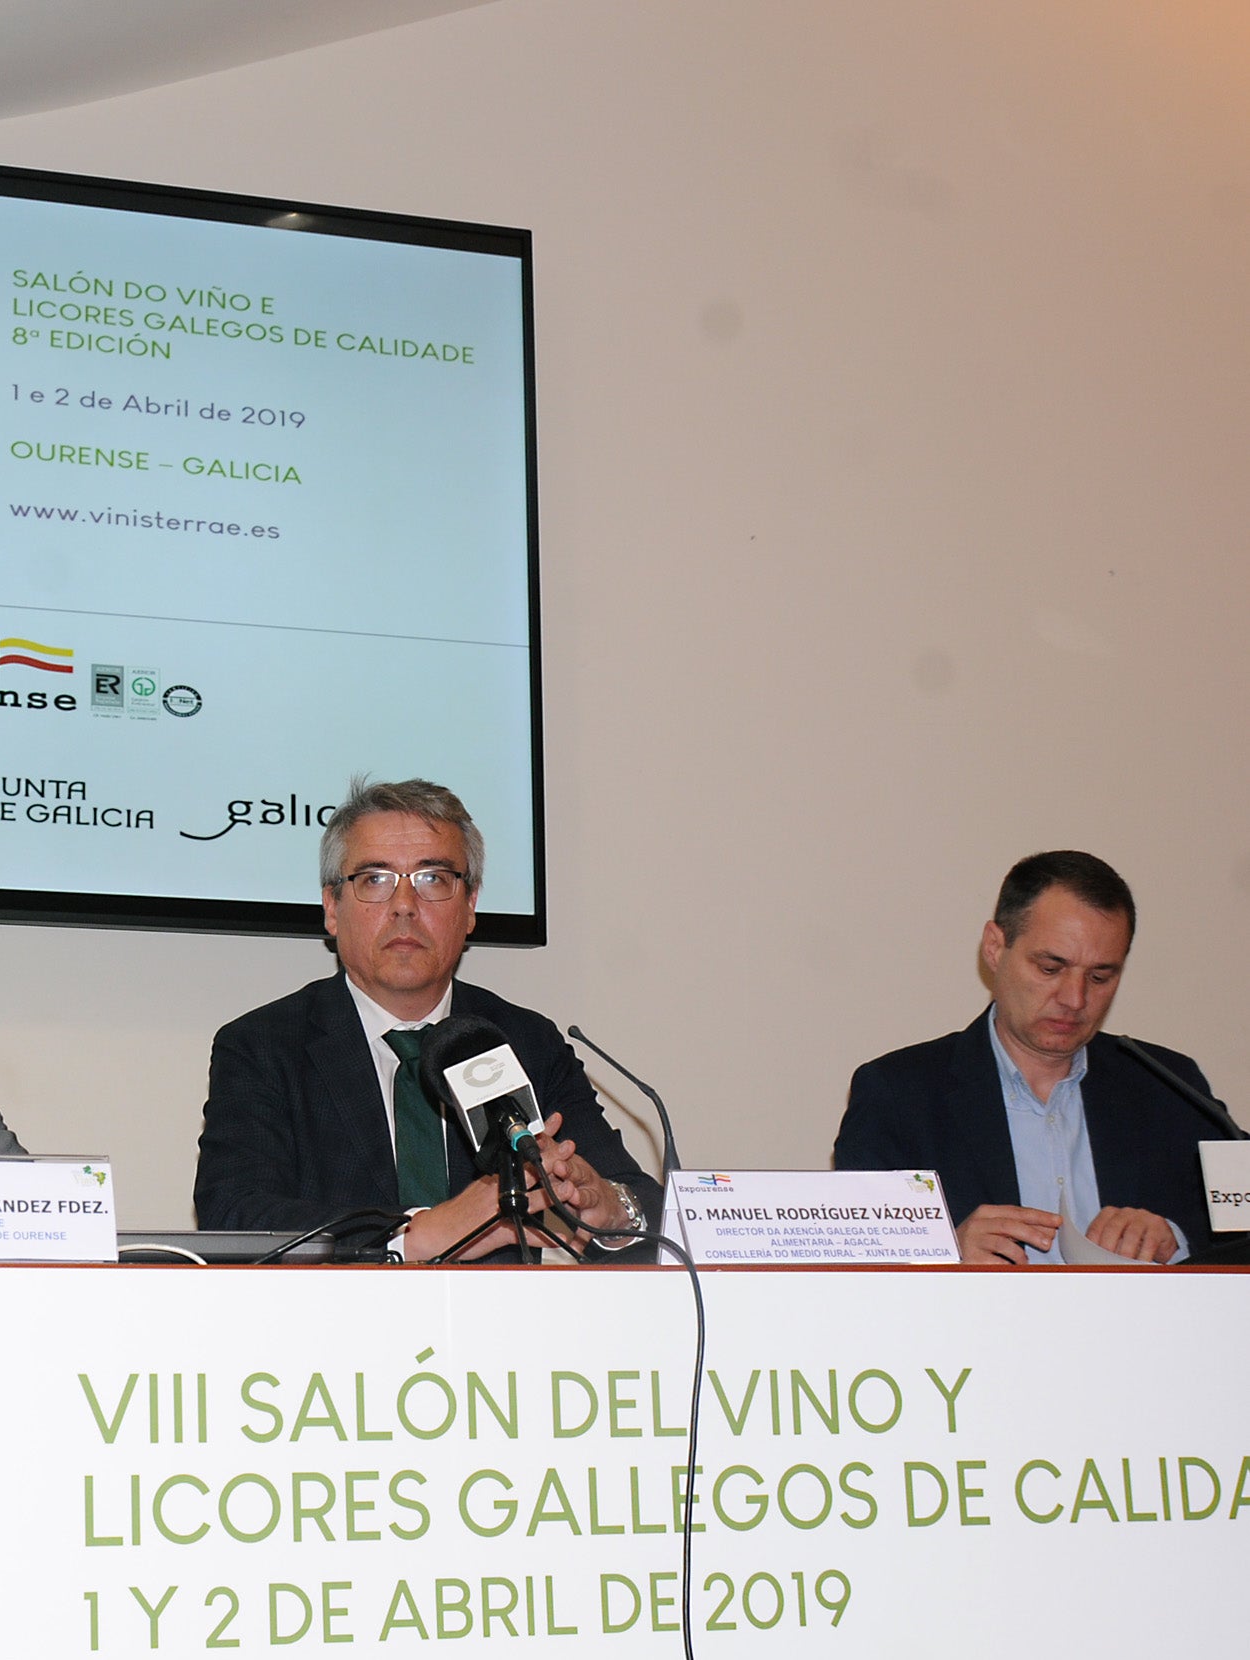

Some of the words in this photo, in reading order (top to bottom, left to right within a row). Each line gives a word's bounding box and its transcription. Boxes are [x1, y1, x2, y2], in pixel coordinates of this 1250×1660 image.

[12, 269, 113, 297] SALÓN
[125, 281, 166, 302] DO
[177, 285, 250, 312] VIÑO
[261, 297, 274, 315] E
[13, 298, 134, 327] LICORES
[144, 313, 284, 343] GALEGOS
[295, 329, 326, 348] DE
[337, 333, 475, 364] CALIDADE
[50, 330, 171, 360] EDICIÓN
[12, 384, 20, 401] 1
[30, 390, 44, 405] e
[55, 388, 69, 406] 2
[80, 390, 112, 410] de
[123, 394, 189, 418] Abril
[200, 402, 231, 421] de
[242, 406, 306, 429] 2019
[10, 441, 149, 471] OURENSE
[183, 457, 302, 485] GALICIA
[10, 503, 280, 540] www.vinisterrae.es
[26, 804, 154, 829] GALICIA
[678, 1185, 734, 1193] Expourense
[59, 1200, 108, 1214] FDEZ.
[686, 1208, 702, 1221] D.
[706, 1208, 772, 1220] MANUEL
[776, 1204, 870, 1220] RODRÍGUEZ
[872, 1203, 943, 1223] VÁZQUEZ
[13, 1231, 67, 1241] OURENSE
[716, 1227, 765, 1236] DIRECTOR
[767, 1227, 778, 1235] DA
[783, 1227, 825, 1235] AXENCIA
[827, 1227, 865, 1235] GALEGA
[867, 1227, 880, 1235] DE
[882, 1226, 929, 1235] CALIDADE
[771, 1238, 834, 1246] ALIMENTARIA
[844, 1238, 883, 1246] AGACAL
[775, 1249, 788, 1258] DO
[791, 1249, 821, 1258] MEDIO
[824, 1249, 856, 1257] RURAL
[865, 1249, 896, 1257] XUNTA
[899, 1248, 911, 1257] DE
[913, 1248, 951, 1257] GALICIA
[77, 1372, 207, 1444] VIII
[240, 1346, 519, 1444] SALÓN
[551, 1369, 687, 1438] DEL
[707, 1368, 902, 1436] VINO
[924, 1368, 972, 1433] Y
[84, 1469, 431, 1547] LICORES
[458, 1461, 879, 1537] GALLEGOS
[904, 1460, 991, 1527] DE
[84, 1592, 99, 1651] 1
[128, 1585, 178, 1649] Y
[204, 1586, 240, 1648] 2
[269, 1581, 354, 1645] DE
[379, 1575, 578, 1642] ABRIL
[600, 1572, 680, 1634] DE
[703, 1569, 851, 1632] 2019
